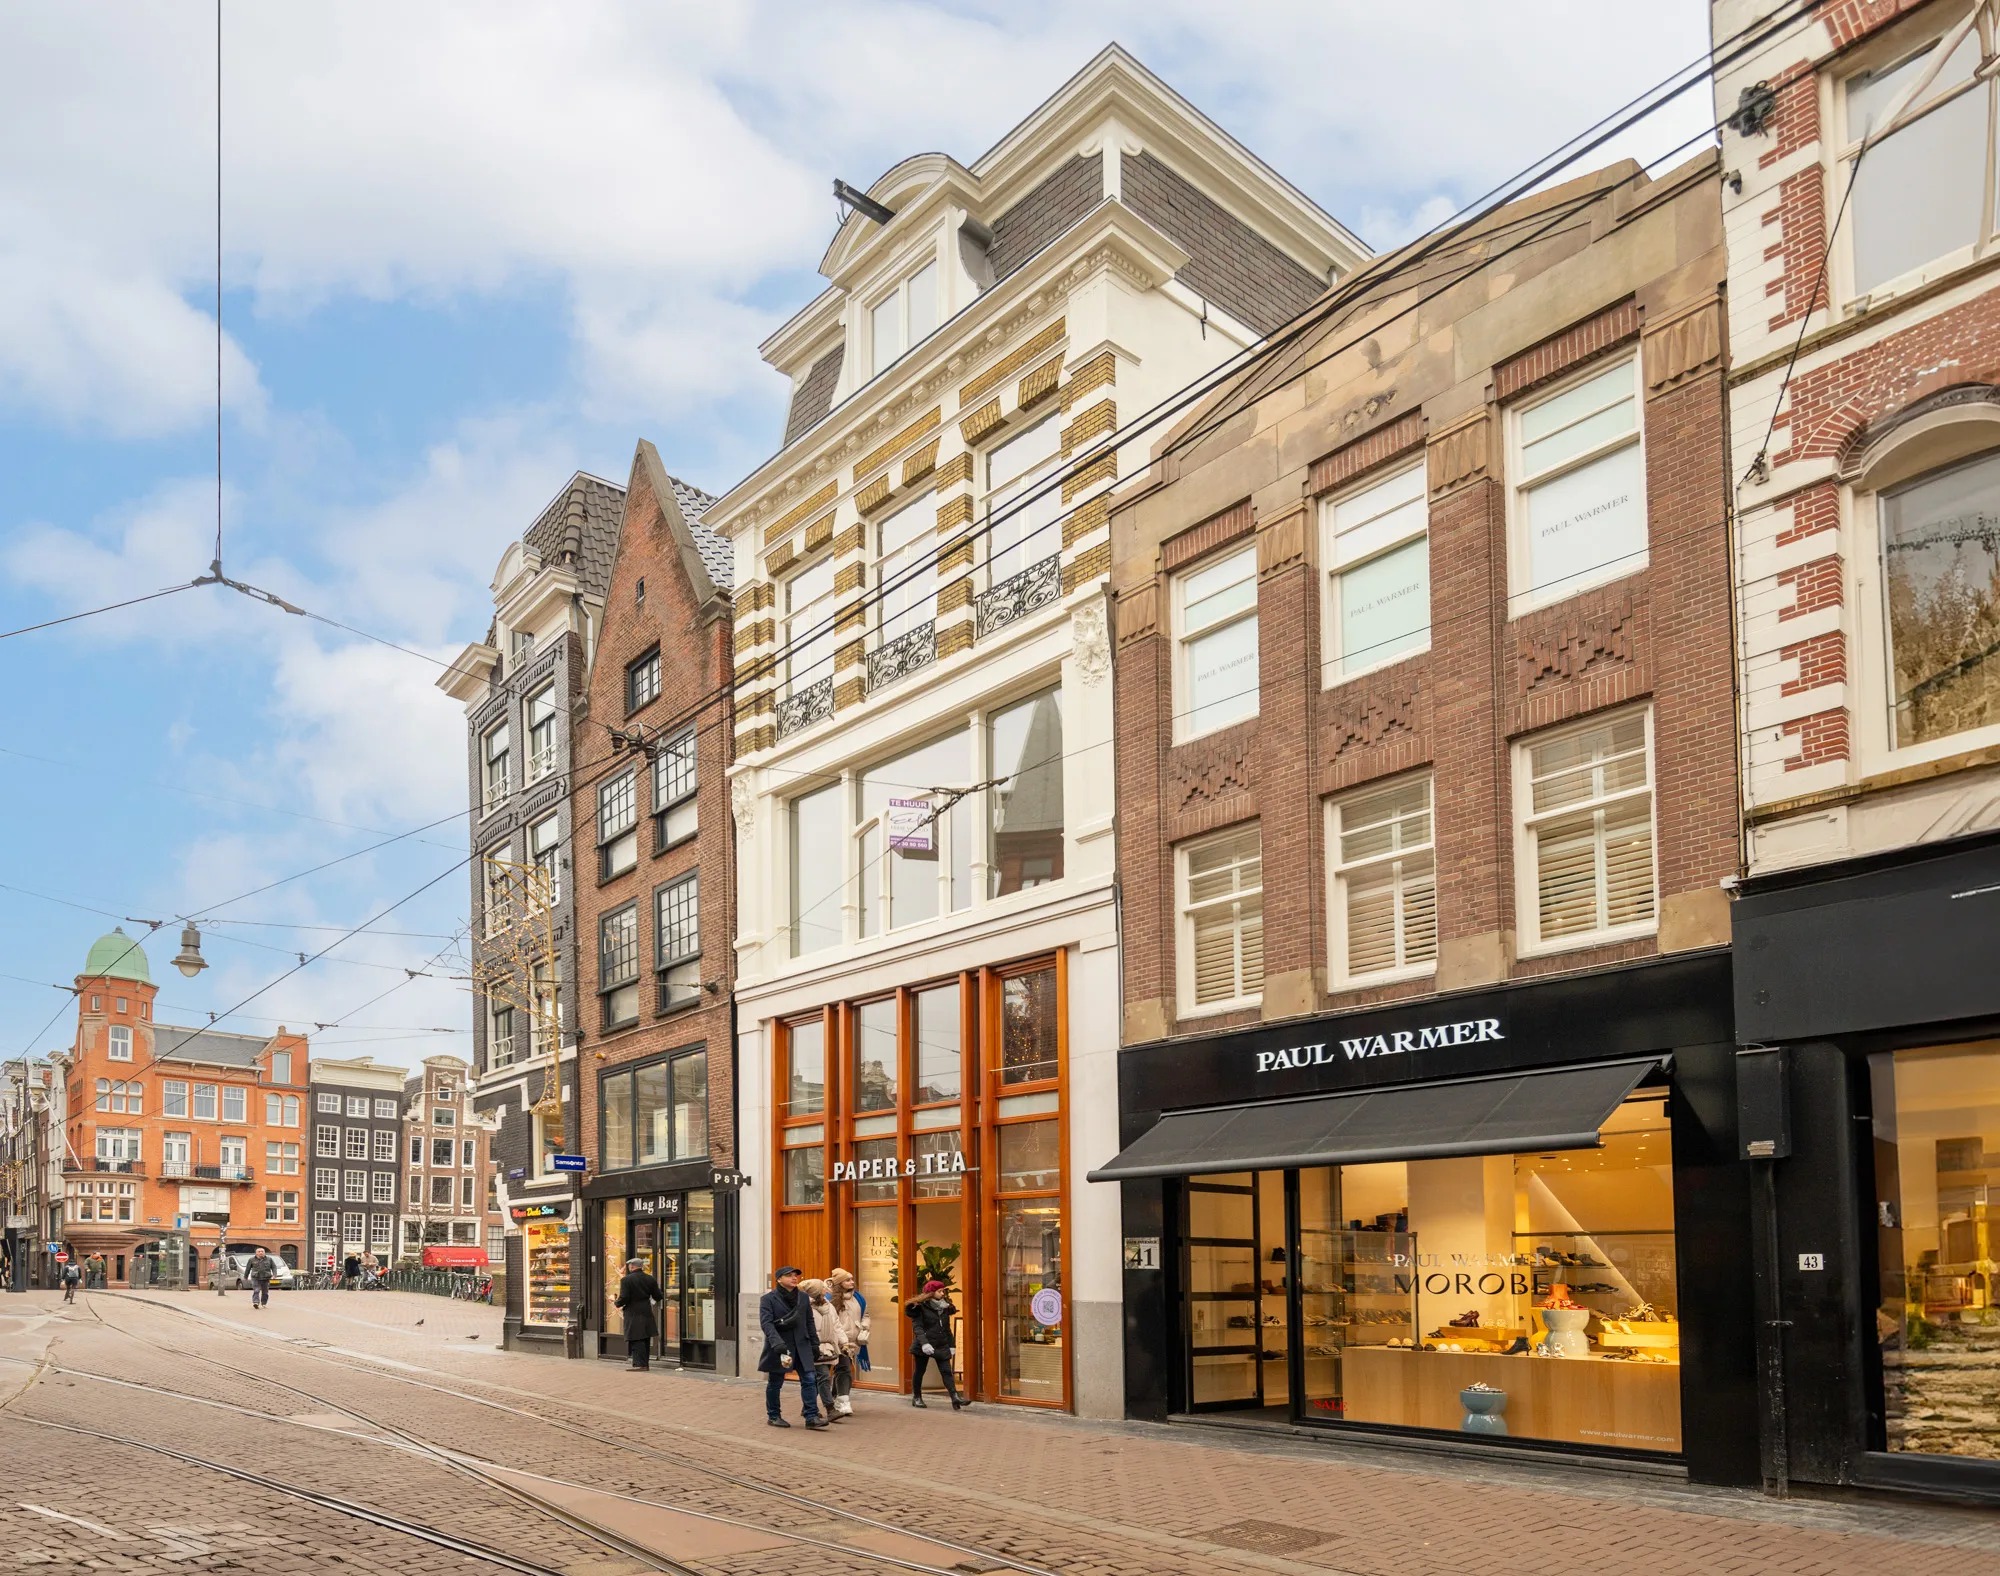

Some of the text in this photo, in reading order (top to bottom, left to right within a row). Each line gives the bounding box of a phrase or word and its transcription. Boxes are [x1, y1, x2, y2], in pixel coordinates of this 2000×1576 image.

[1542, 495, 1629, 537] PAUL WARMER
[1350, 583, 1419, 618] PAUL WARMER
[1198, 652, 1254, 681] PAUL WARMER
[1257, 1018, 1505, 1072] PAUL WARMER
[834, 1151, 966, 1180] PAPER & TEA
[714, 1173, 721, 1183] P
[732, 1175, 739, 1184] T
[634, 1195, 678, 1214] Mag Bag
[1130, 1247, 1155, 1266] 41
[1394, 1254, 1444, 1267] PAUL
[1804, 1256, 1818, 1268] 43
[1313, 1399, 1348, 1411] SALE
[1580, 1429, 1675, 1442] www.paulwarmer.com
